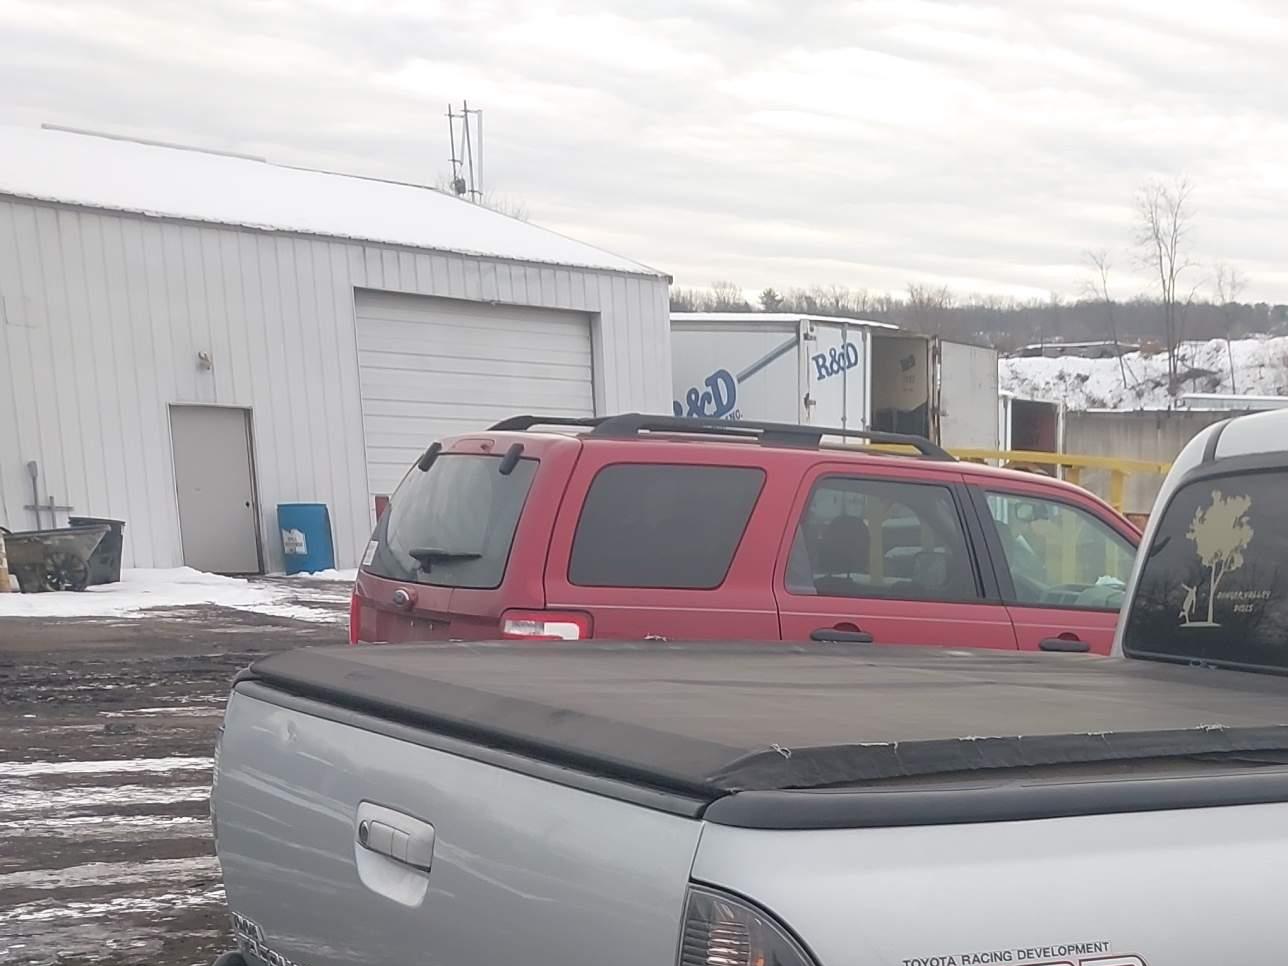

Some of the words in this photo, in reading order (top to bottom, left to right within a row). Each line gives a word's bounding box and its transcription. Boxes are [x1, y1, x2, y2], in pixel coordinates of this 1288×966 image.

[812, 342, 858, 381] R&D
[673, 369, 736, 417] &D
[961, 951, 1013, 965] RACING
[1017, 941, 1110, 960] DEVELOPMENT
